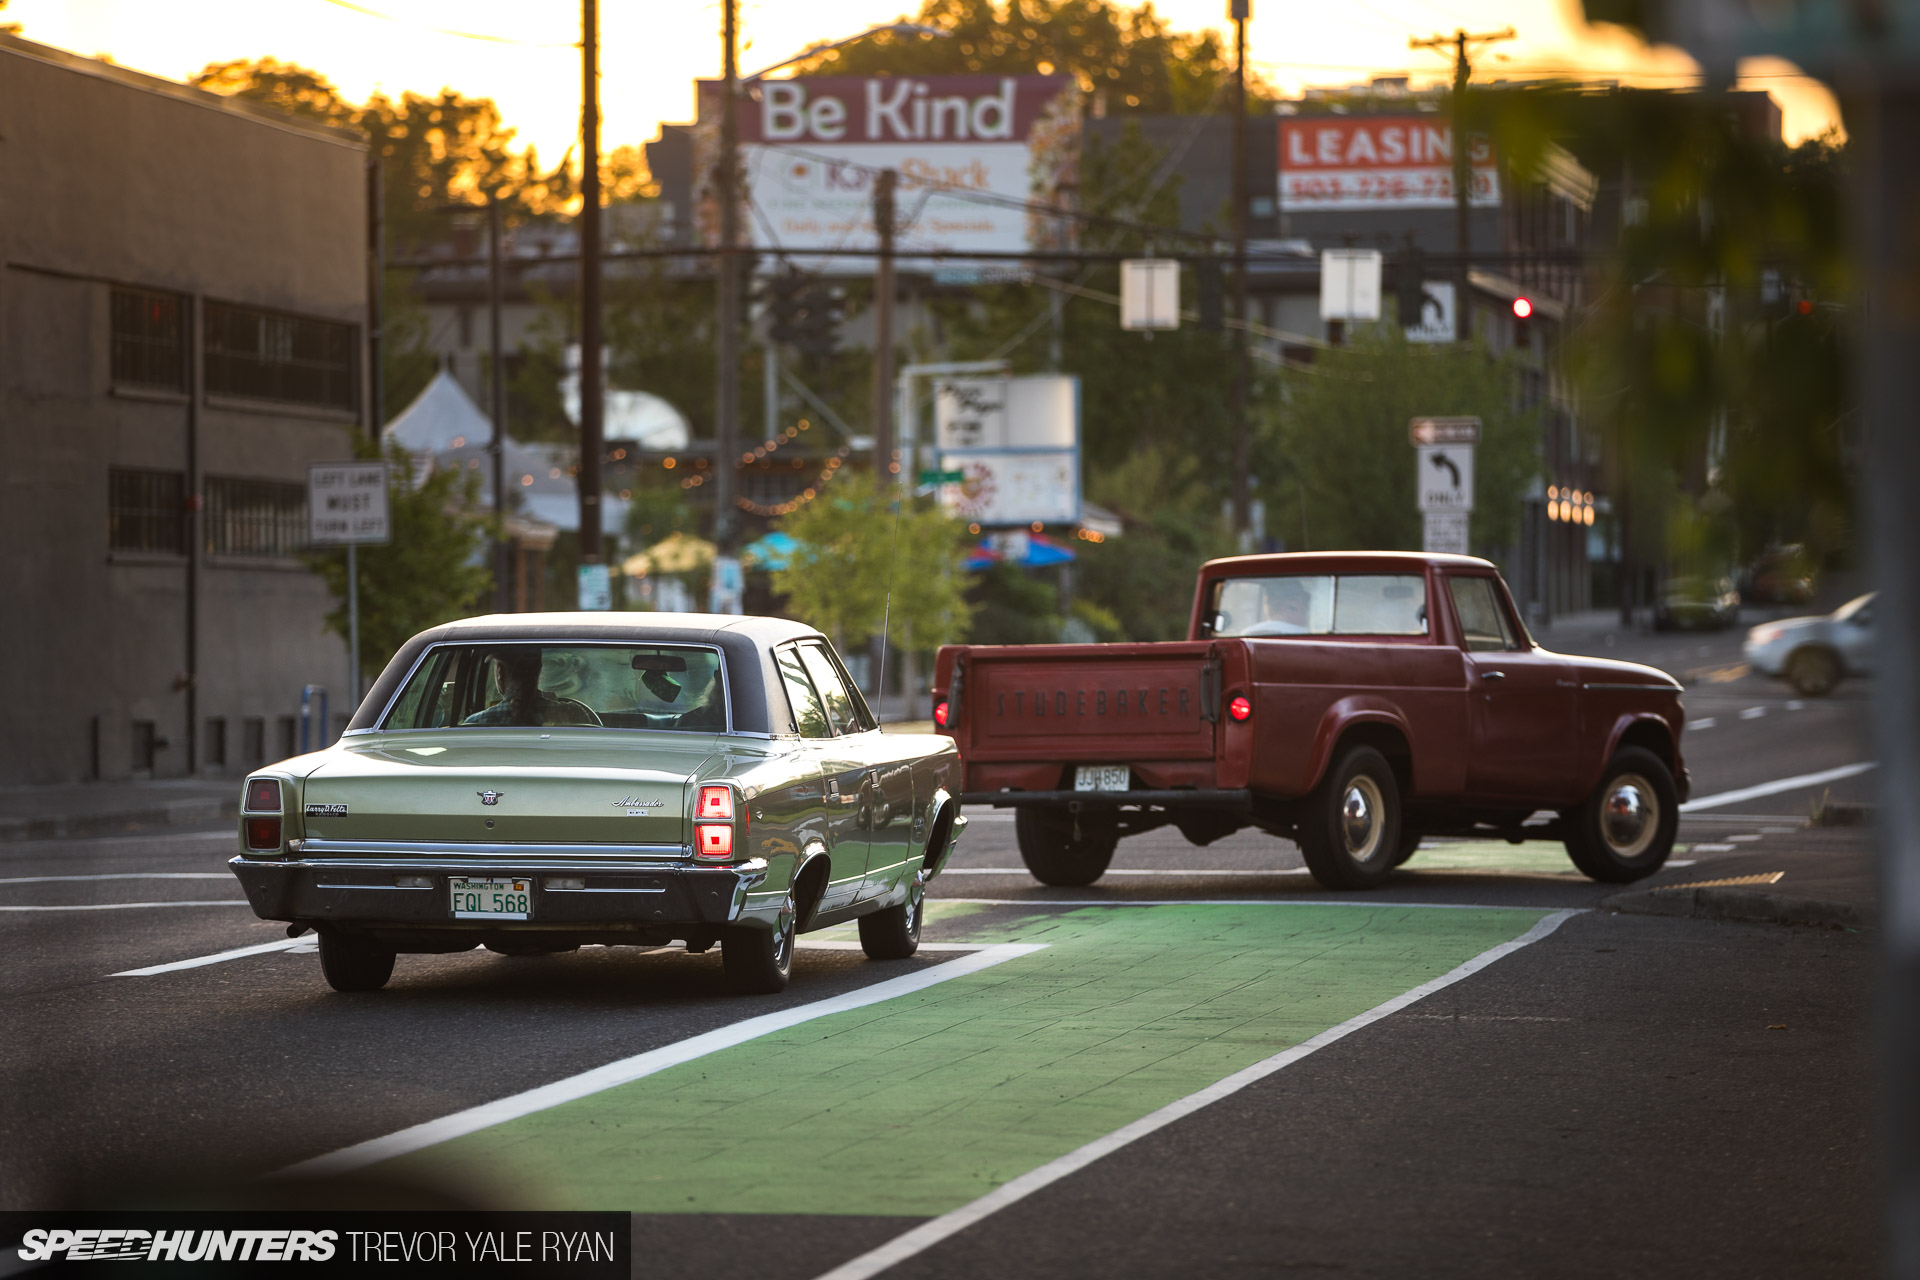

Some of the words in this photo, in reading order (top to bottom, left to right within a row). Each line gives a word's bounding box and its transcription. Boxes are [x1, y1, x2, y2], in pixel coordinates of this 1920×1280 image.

[762, 81, 847, 140] Be
[865, 78, 1017, 140] Kind
[1288, 126, 1490, 165] LEASING
[314, 471, 344, 488] LEFT
[348, 470, 381, 488] LANE
[327, 494, 370, 512] MUST
[315, 518, 348, 533] TURN
[352, 517, 384, 534] LEFT
[996, 687, 1191, 717] STUDEBAKER
[1104, 768, 1126, 785] 850
[611, 795, 665, 808] Ambassador
[453, 882, 505, 890] WASHINGTON
[454, 892, 488, 912] EQL
[493, 893, 528, 913] 568
